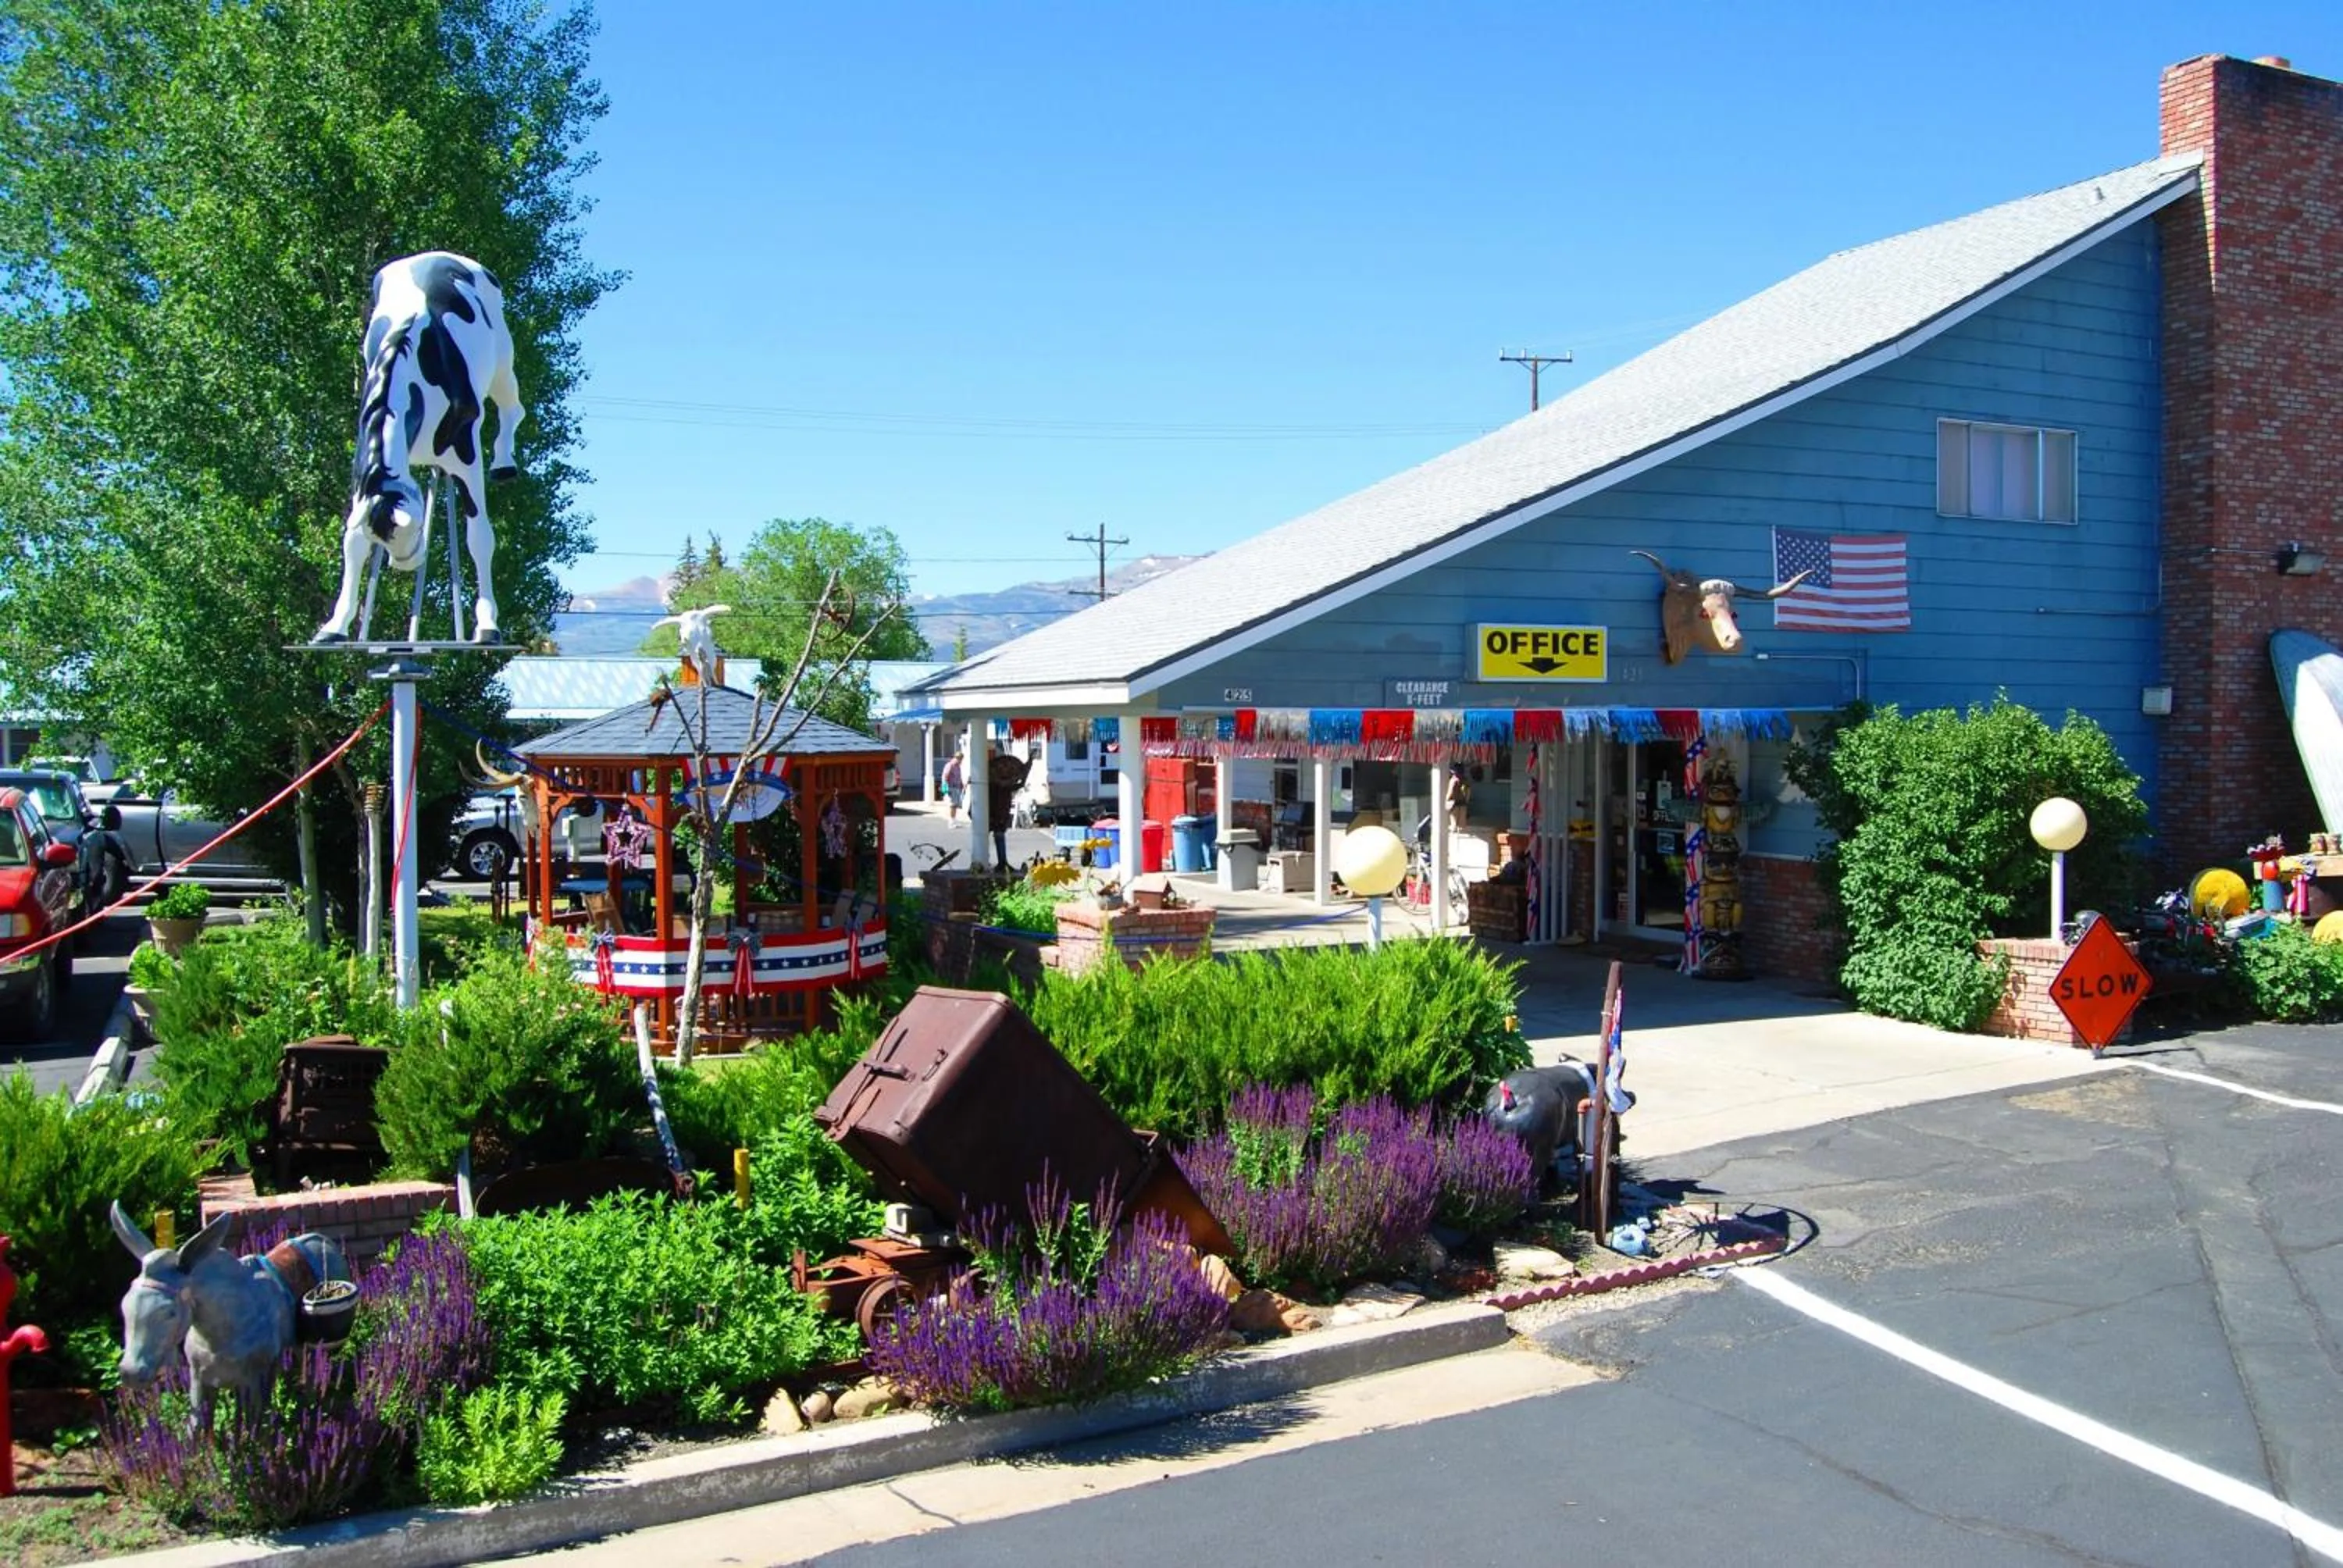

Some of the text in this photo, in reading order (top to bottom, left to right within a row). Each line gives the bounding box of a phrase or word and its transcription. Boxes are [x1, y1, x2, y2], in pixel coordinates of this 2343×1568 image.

[1486, 631, 1599, 655] OFFICE
[1396, 681, 1449, 693] CLEARANCE
[2060, 974, 2138, 999] SLOW
